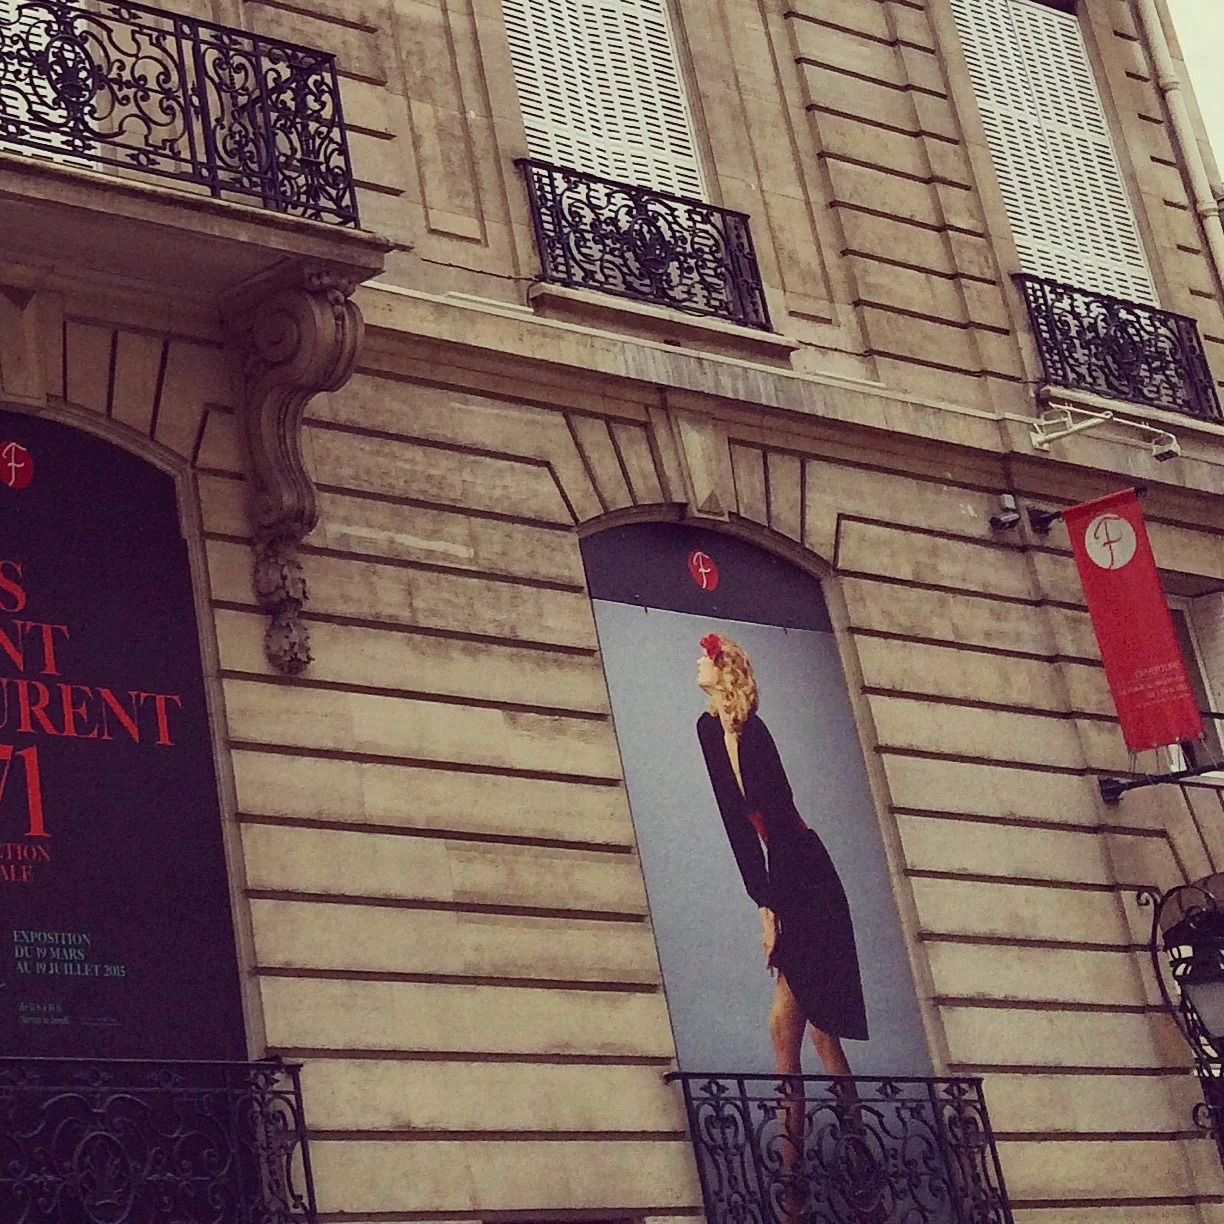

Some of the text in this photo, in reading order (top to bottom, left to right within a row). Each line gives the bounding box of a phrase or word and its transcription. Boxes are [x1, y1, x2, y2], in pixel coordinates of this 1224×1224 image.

[13, 930, 91, 948] EXPOSITION
[15, 945, 85, 961] DU 19 MARS
[16, 961, 33, 974] AU
[49, 962, 101, 977] JUILLET
[104, 964, 126, 977] 2015
